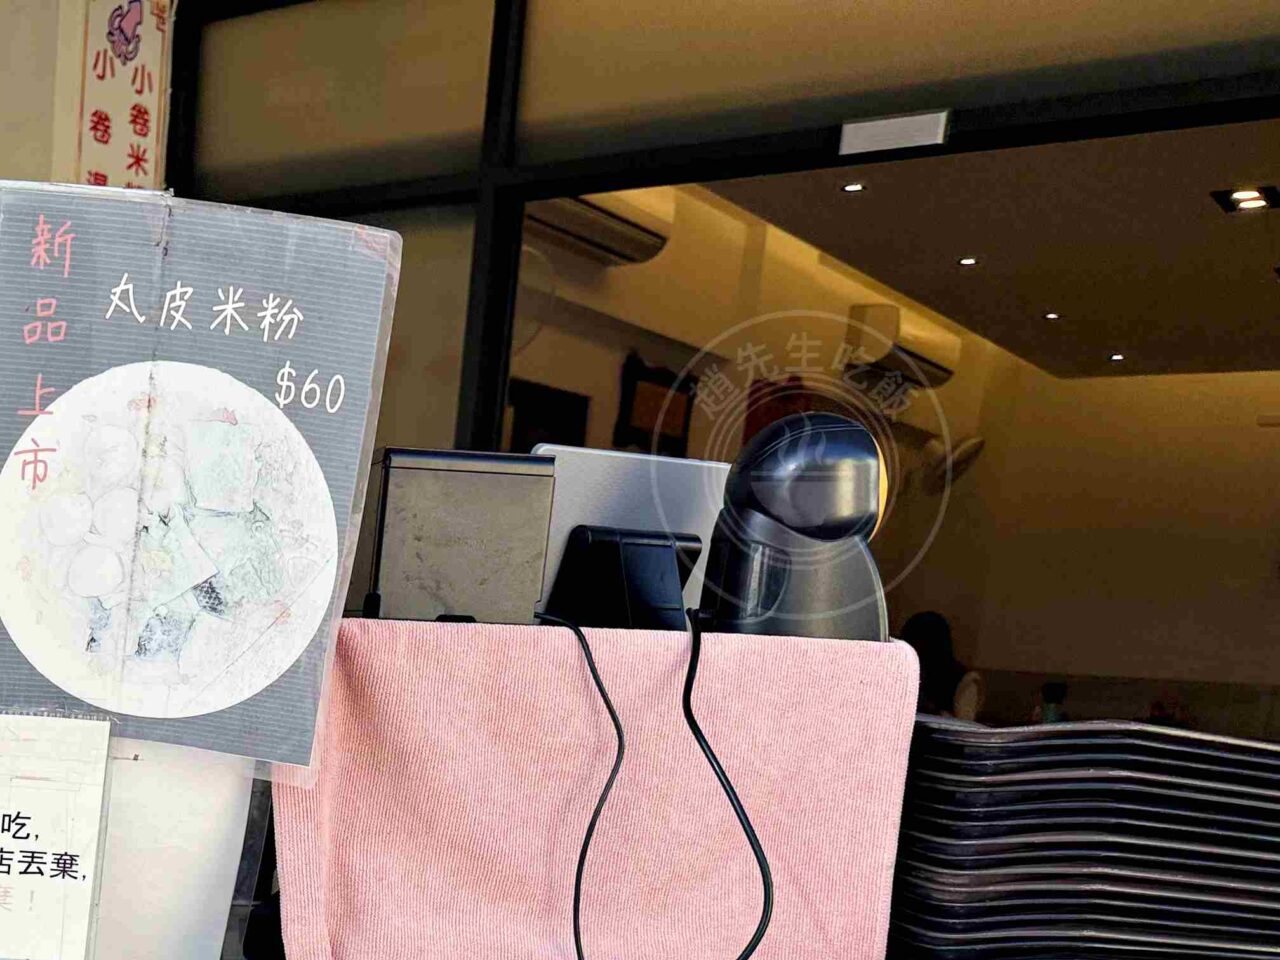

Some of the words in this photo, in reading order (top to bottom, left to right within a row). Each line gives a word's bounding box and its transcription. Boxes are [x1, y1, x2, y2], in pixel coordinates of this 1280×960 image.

[126, 64, 153, 188] 小卷米
[14, 215, 74, 491] 新品上市
[105, 273, 305, 341] 丸皮米粉
[275, 361, 346, 414] $60
